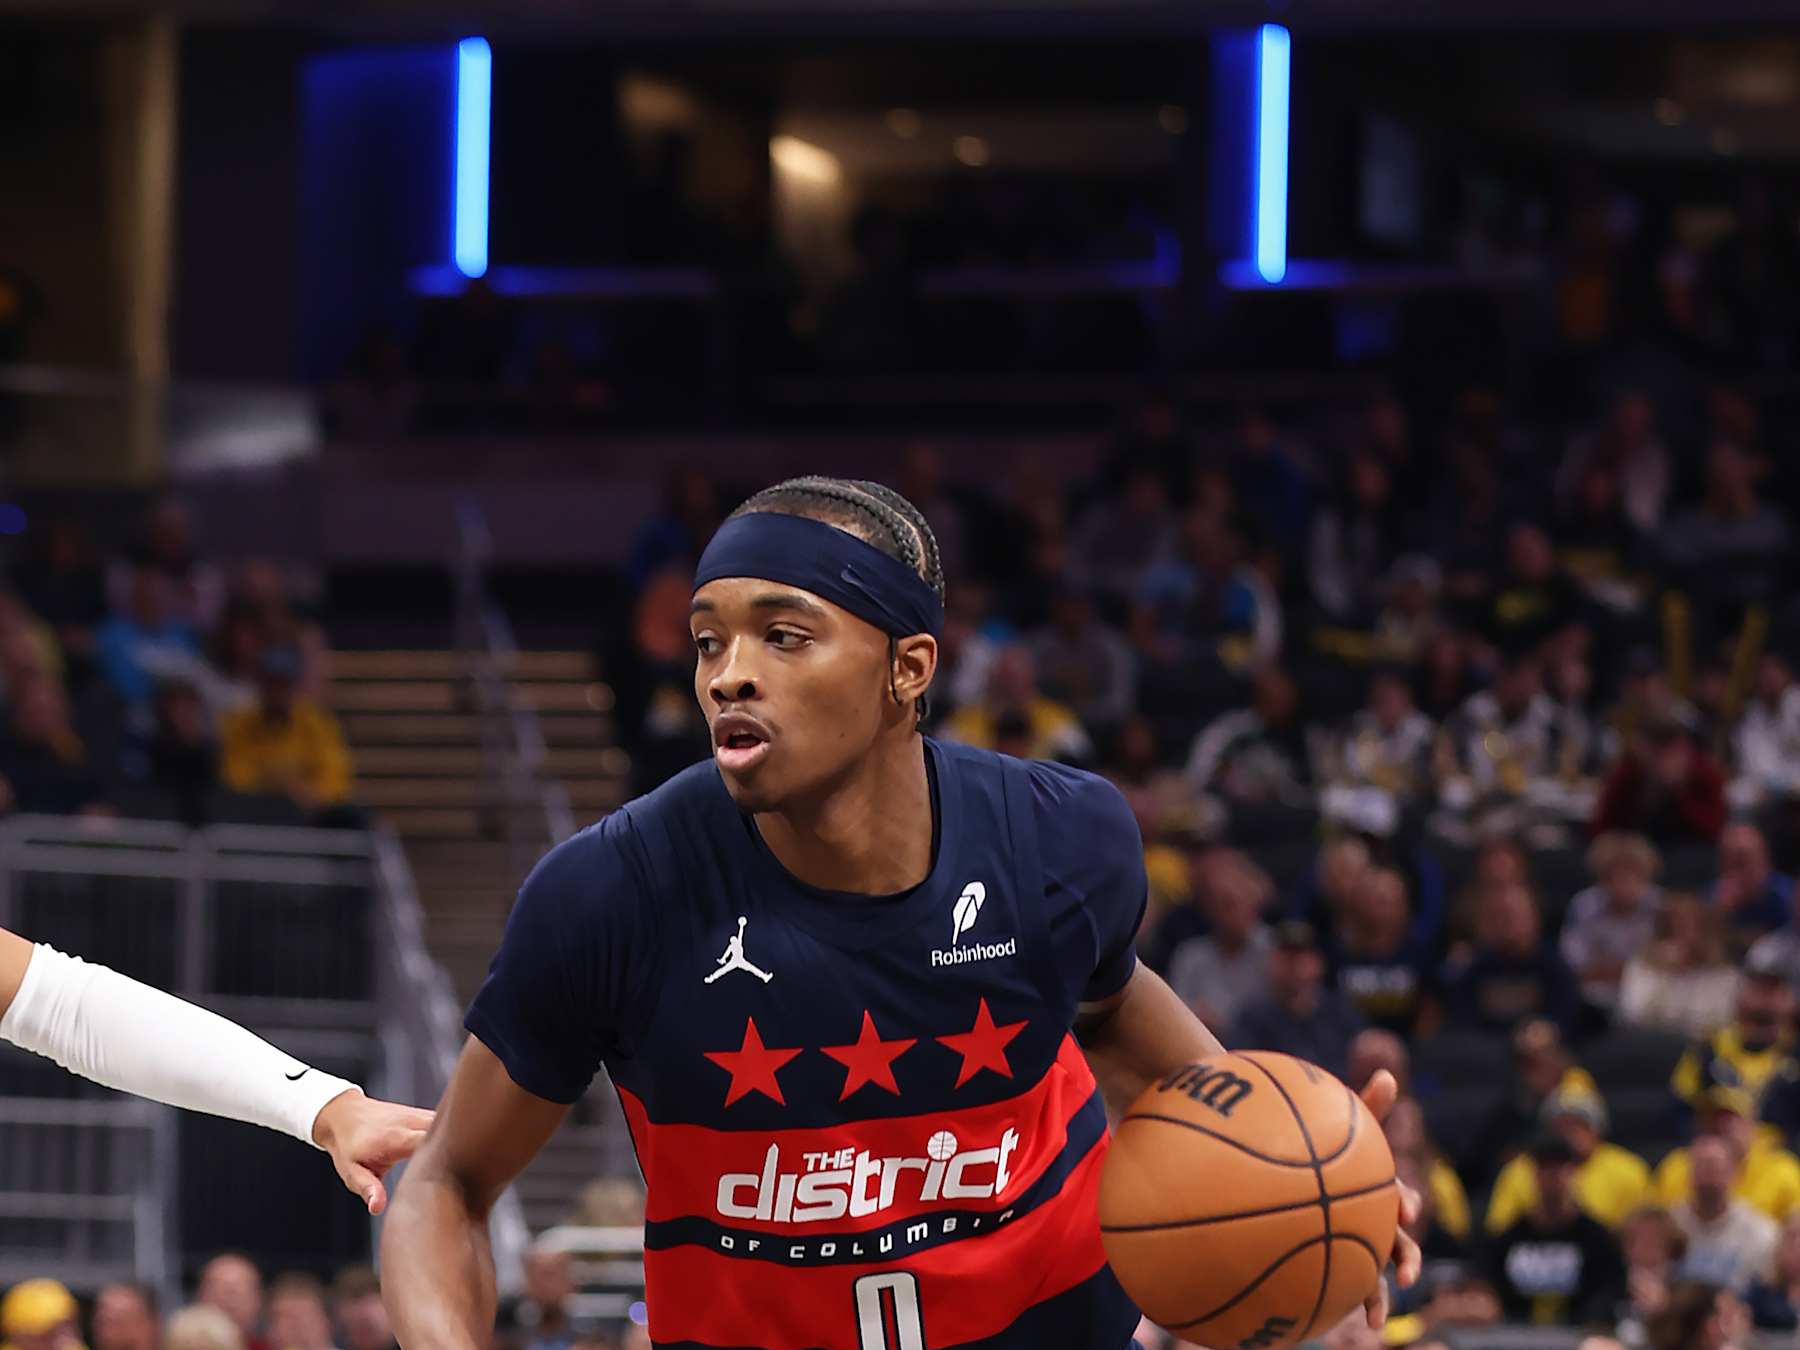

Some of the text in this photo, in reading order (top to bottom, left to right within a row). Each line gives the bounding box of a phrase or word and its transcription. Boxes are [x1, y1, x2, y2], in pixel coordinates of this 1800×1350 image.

[930, 937, 1017, 967] Robinhood
[803, 1147, 856, 1171] THE
[716, 1126, 1020, 1223] district
[720, 1234, 761, 1251] OF
